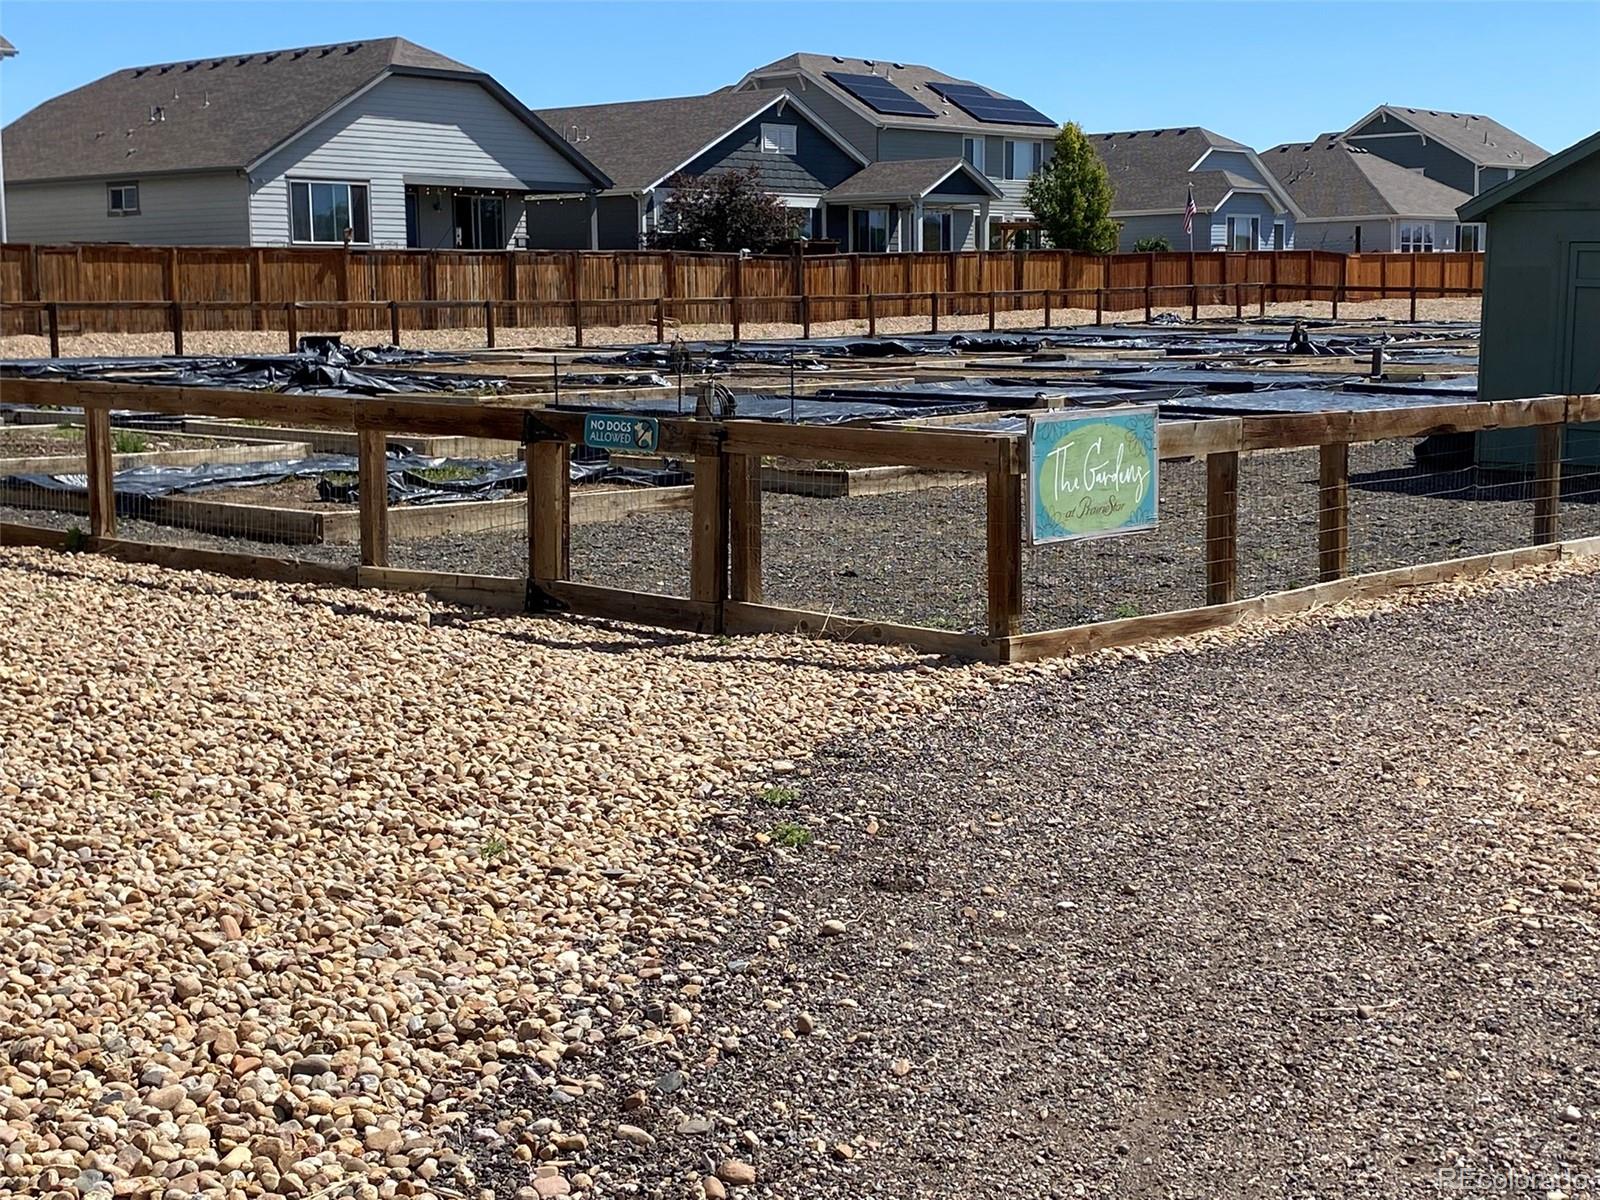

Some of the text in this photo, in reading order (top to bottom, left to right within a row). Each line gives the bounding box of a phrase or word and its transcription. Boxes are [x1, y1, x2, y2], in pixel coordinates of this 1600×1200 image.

[590, 420, 632, 432] NO DOGS
[589, 431, 632, 444] ALLOWED
[1047, 436, 1151, 503] The Gardens
[1065, 505, 1076, 518] at
